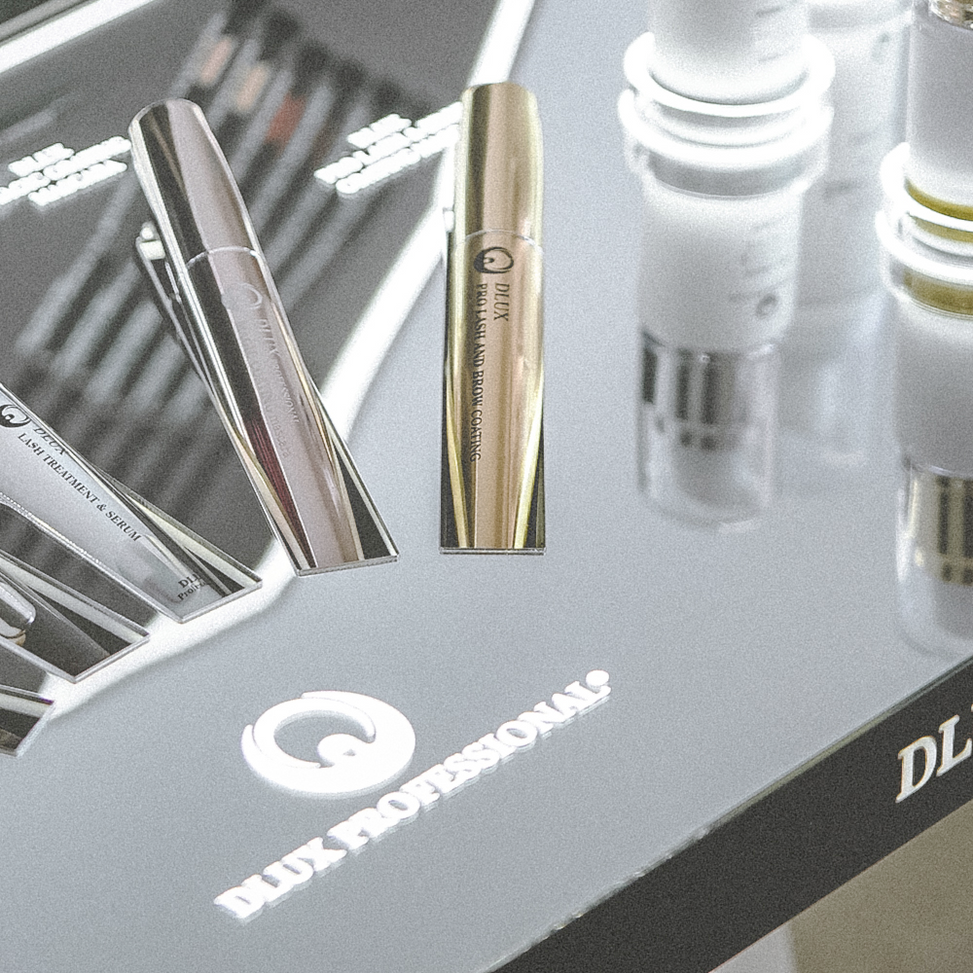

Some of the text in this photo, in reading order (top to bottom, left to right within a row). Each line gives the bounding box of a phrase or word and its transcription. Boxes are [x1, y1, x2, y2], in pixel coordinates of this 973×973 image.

[493, 282, 510, 322] DLUX
[469, 283, 488, 463] PRO LASH AND BROW COATING
[33, 426, 67, 456] DLUX
[17, 432, 142, 542] LASH TREATMENT & SERUM
[895, 703, 973, 803] DL
[213, 837, 347, 920] DLUX
